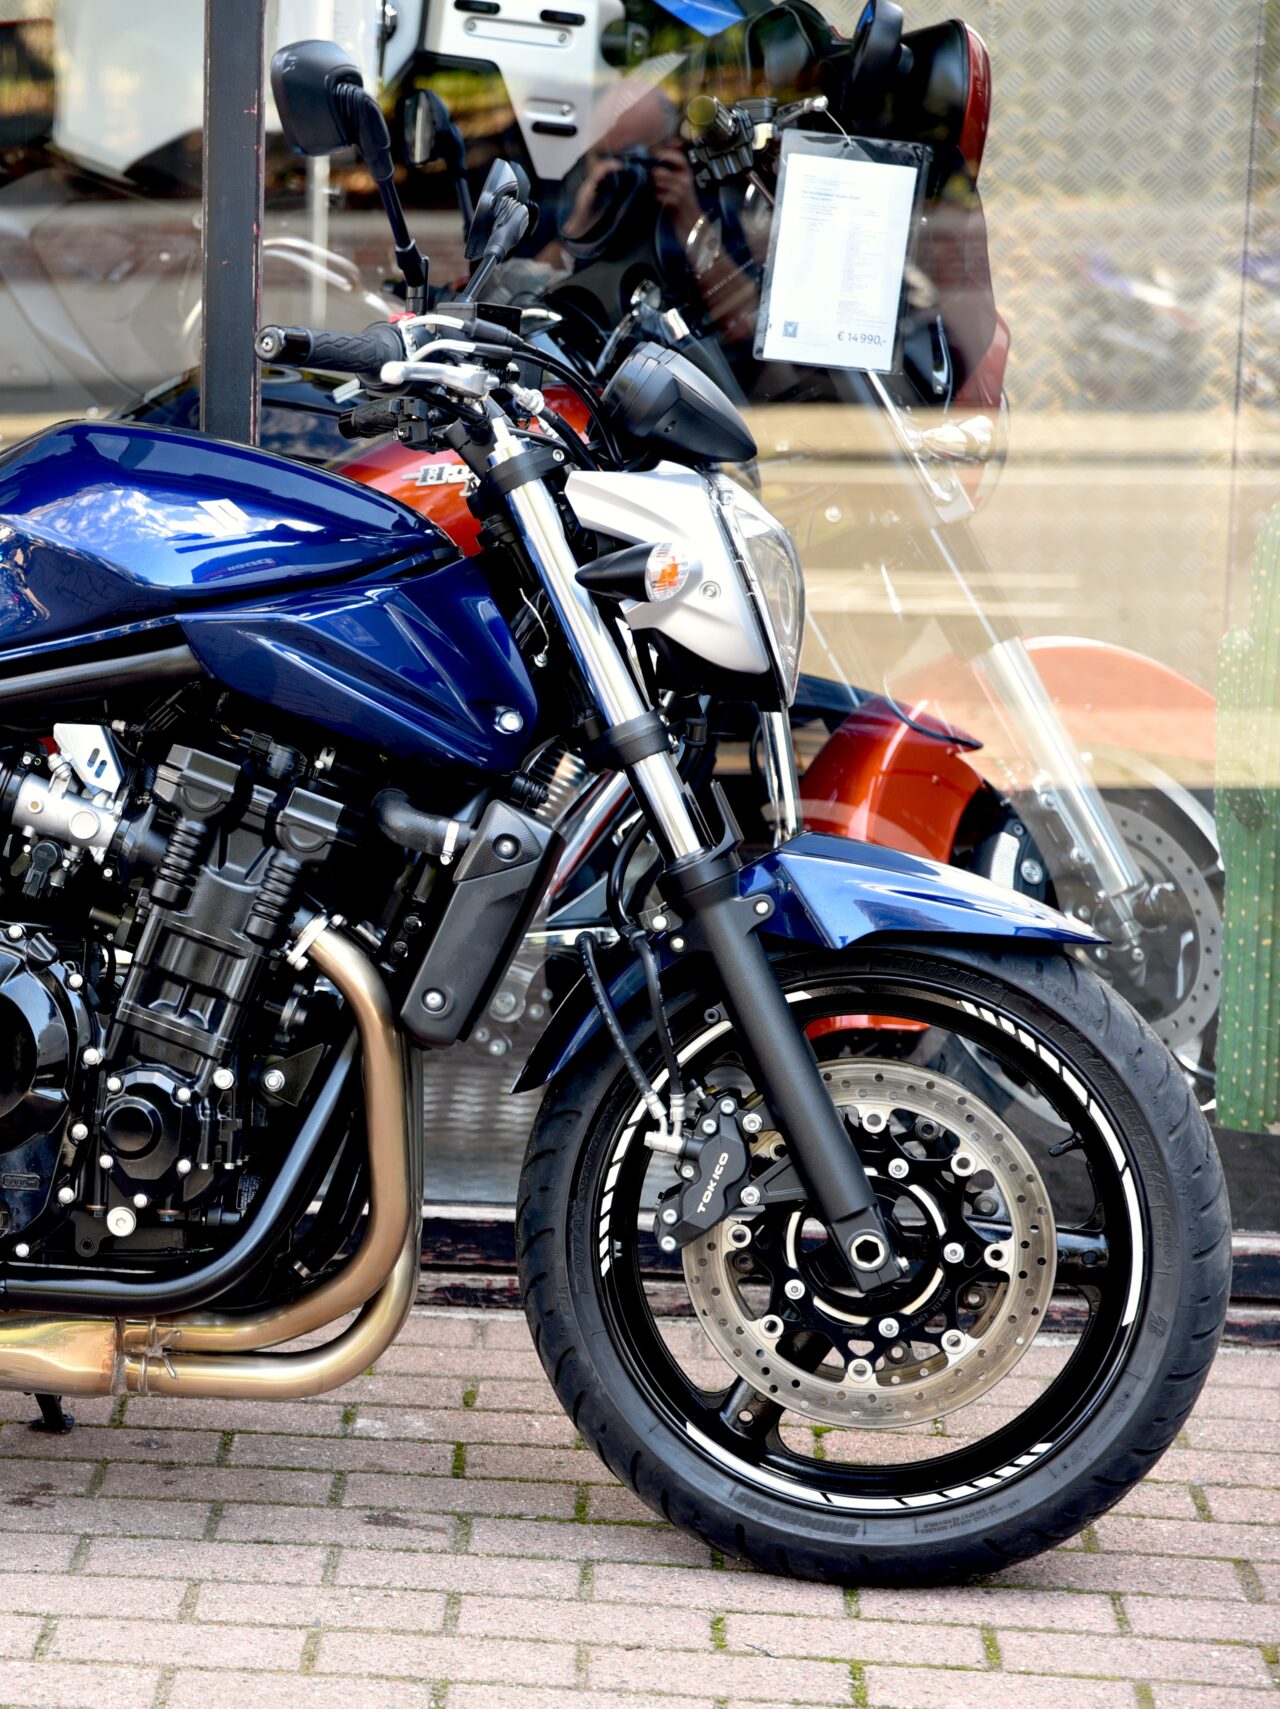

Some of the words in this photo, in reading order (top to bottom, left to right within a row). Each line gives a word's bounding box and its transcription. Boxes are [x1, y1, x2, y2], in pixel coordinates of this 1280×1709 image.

[837, 330, 845, 341] €
[876, 953, 1003, 997] BRIDGESTONE
[696, 1152, 730, 1213] TOKICO
[733, 1491, 859, 1538] BRIDGESTONE
